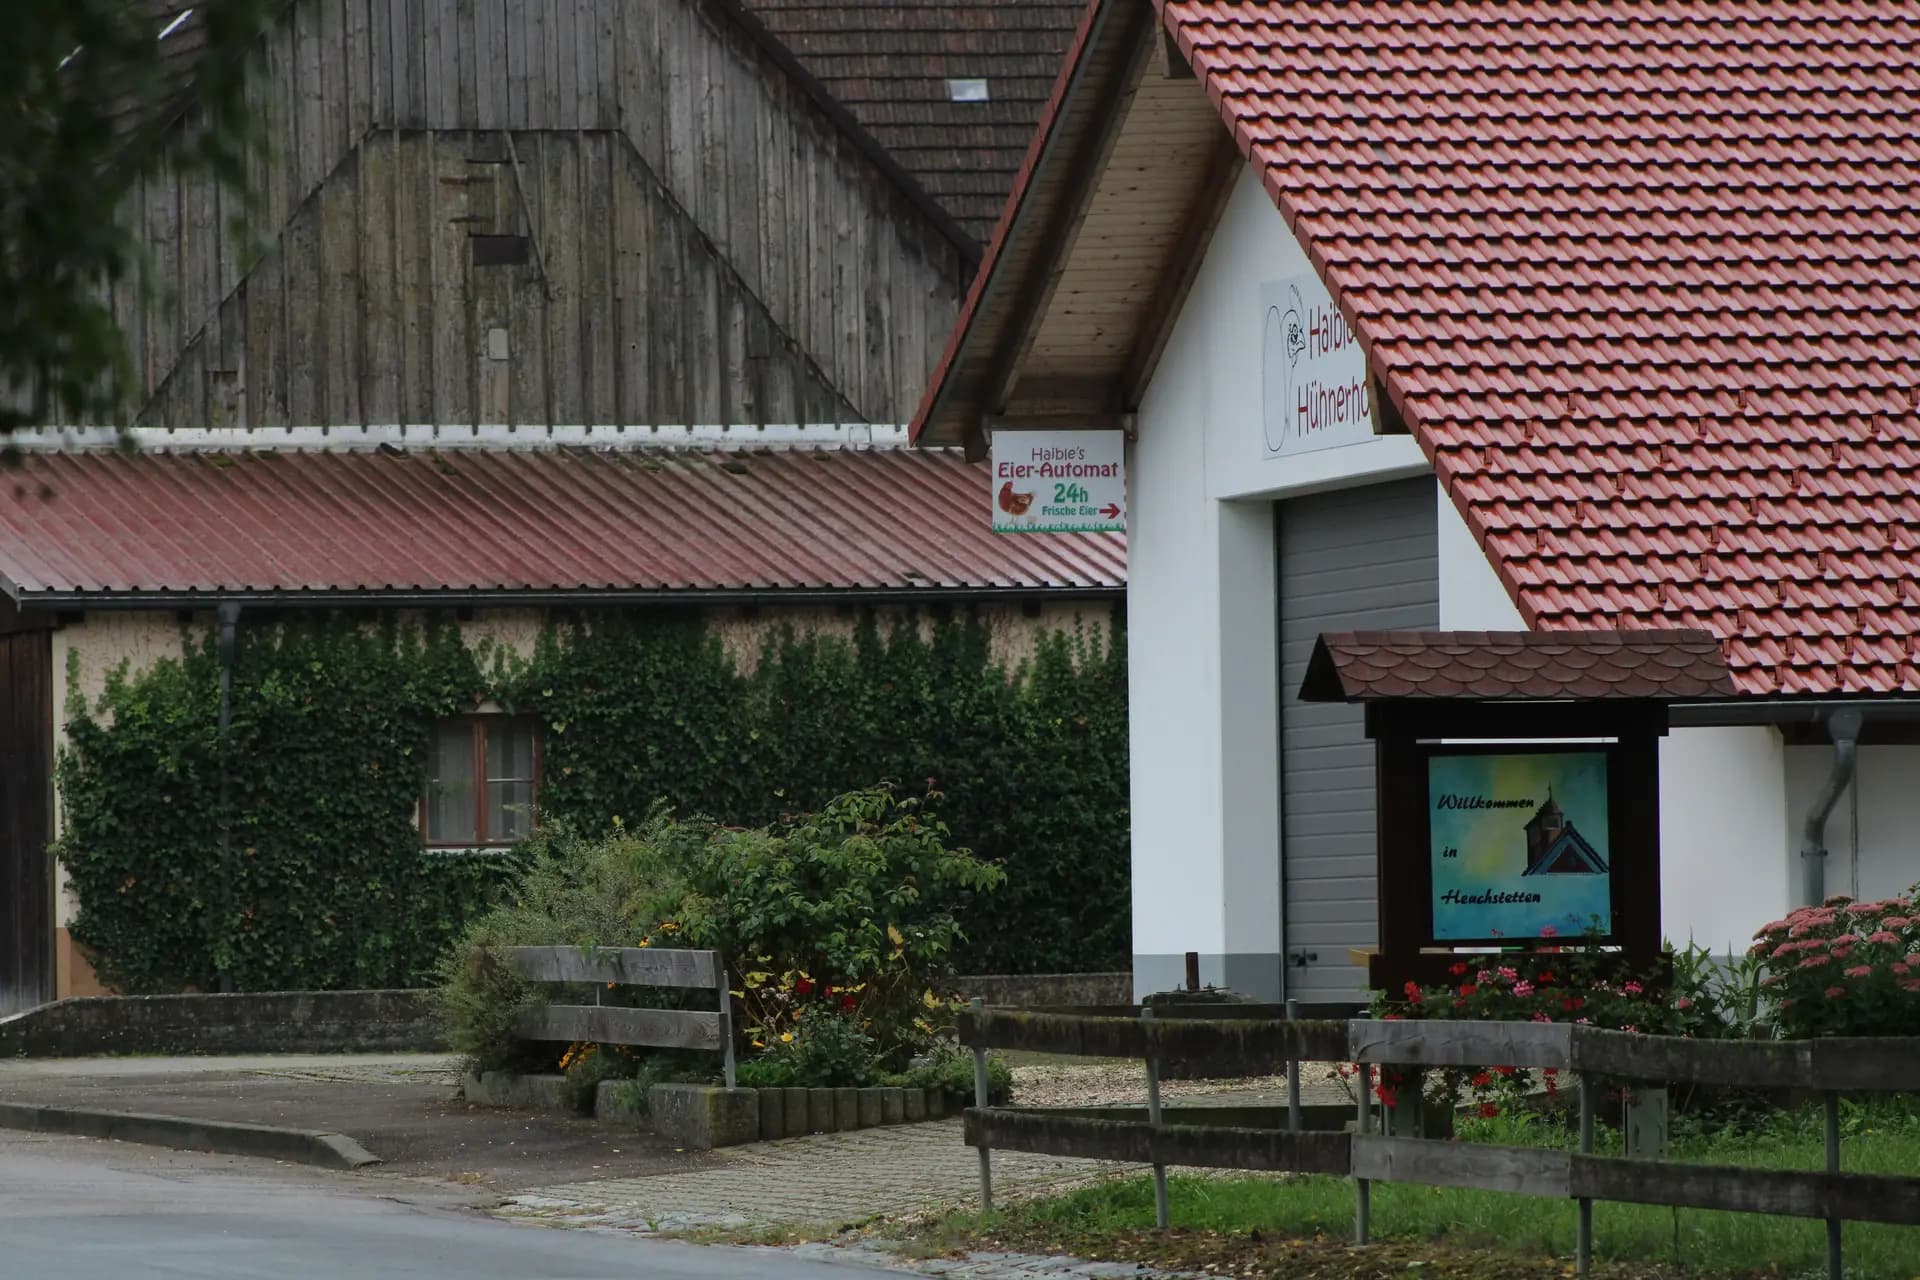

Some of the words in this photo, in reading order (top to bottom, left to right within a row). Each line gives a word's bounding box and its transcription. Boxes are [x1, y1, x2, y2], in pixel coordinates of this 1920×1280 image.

[1032, 446, 1085, 461] Haible's
[998, 462, 1118, 478] Eier-Automat
[1054, 483, 1088, 503] 24h
[1042, 506, 1076, 516] Frische
[1079, 506, 1097, 516] Eier
[1437, 794, 1534, 810] Willkommen
[1443, 846, 1457, 858] in
[1441, 888, 1541, 905] Heuchstetten
